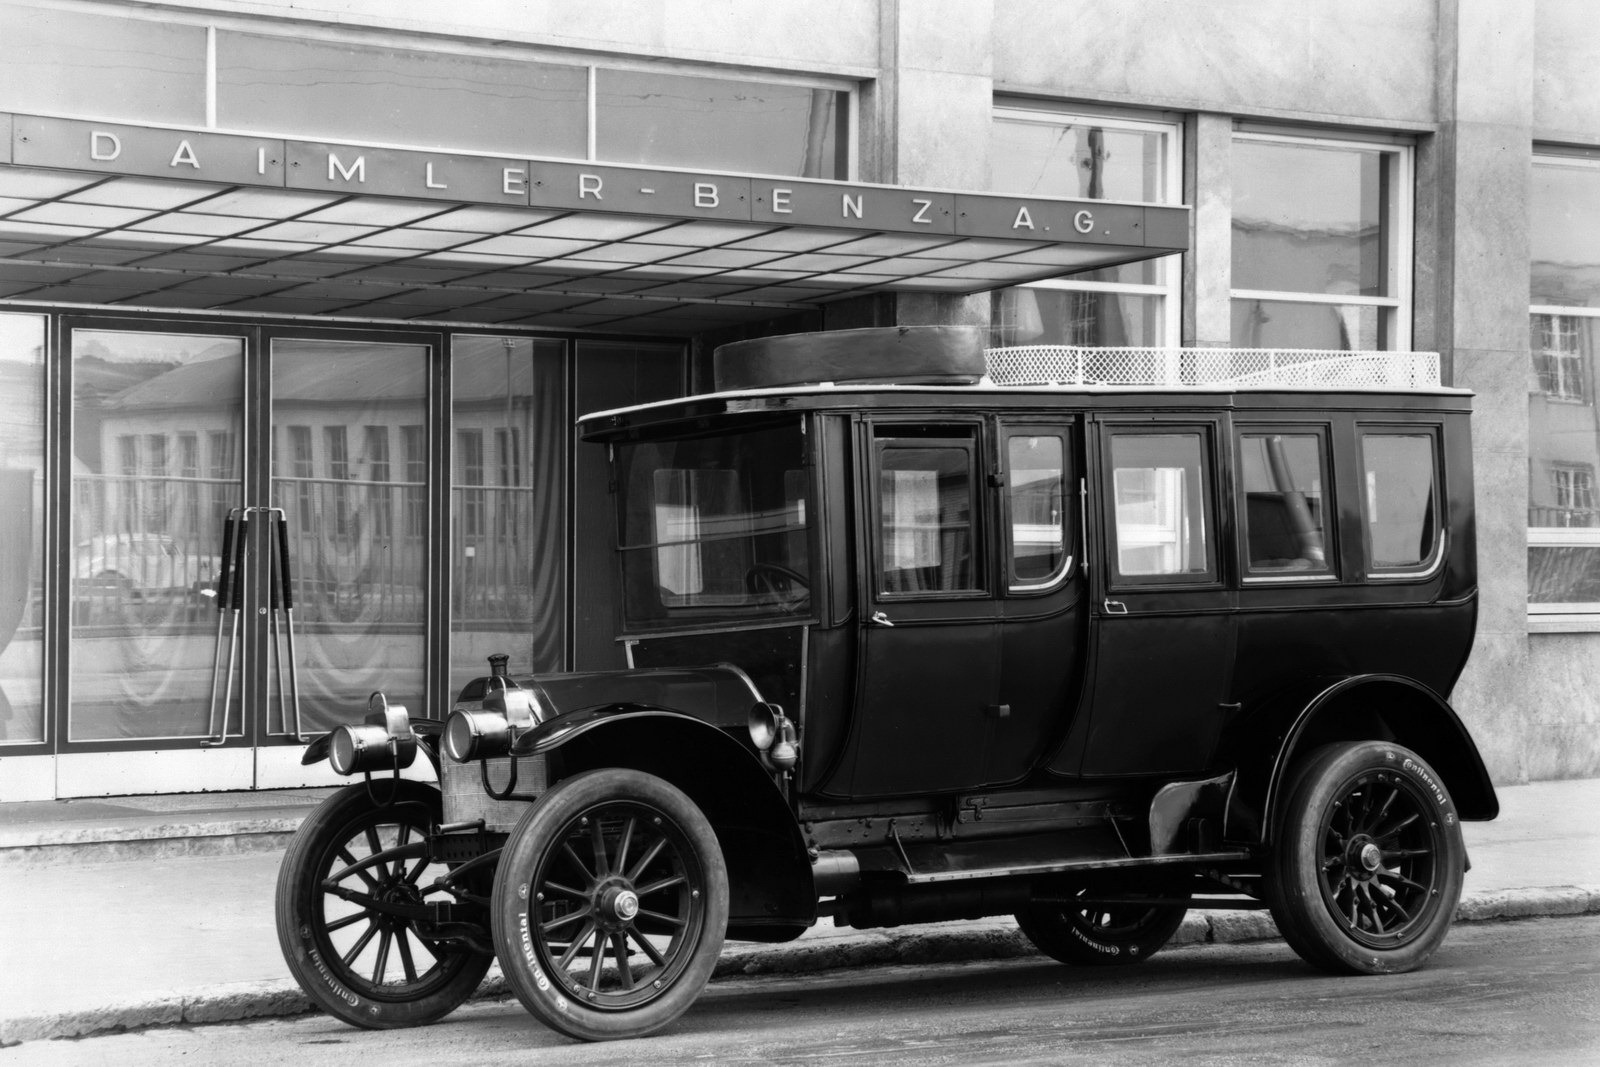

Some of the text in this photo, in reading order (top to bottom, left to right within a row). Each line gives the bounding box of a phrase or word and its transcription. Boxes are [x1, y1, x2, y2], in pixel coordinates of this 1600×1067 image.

[90, 130, 932, 224] DAIMLER-BENZ
[1403, 758, 1447, 805] Continental
[308, 948, 359, 1007] Continental
[518, 912, 550, 991] Continental
